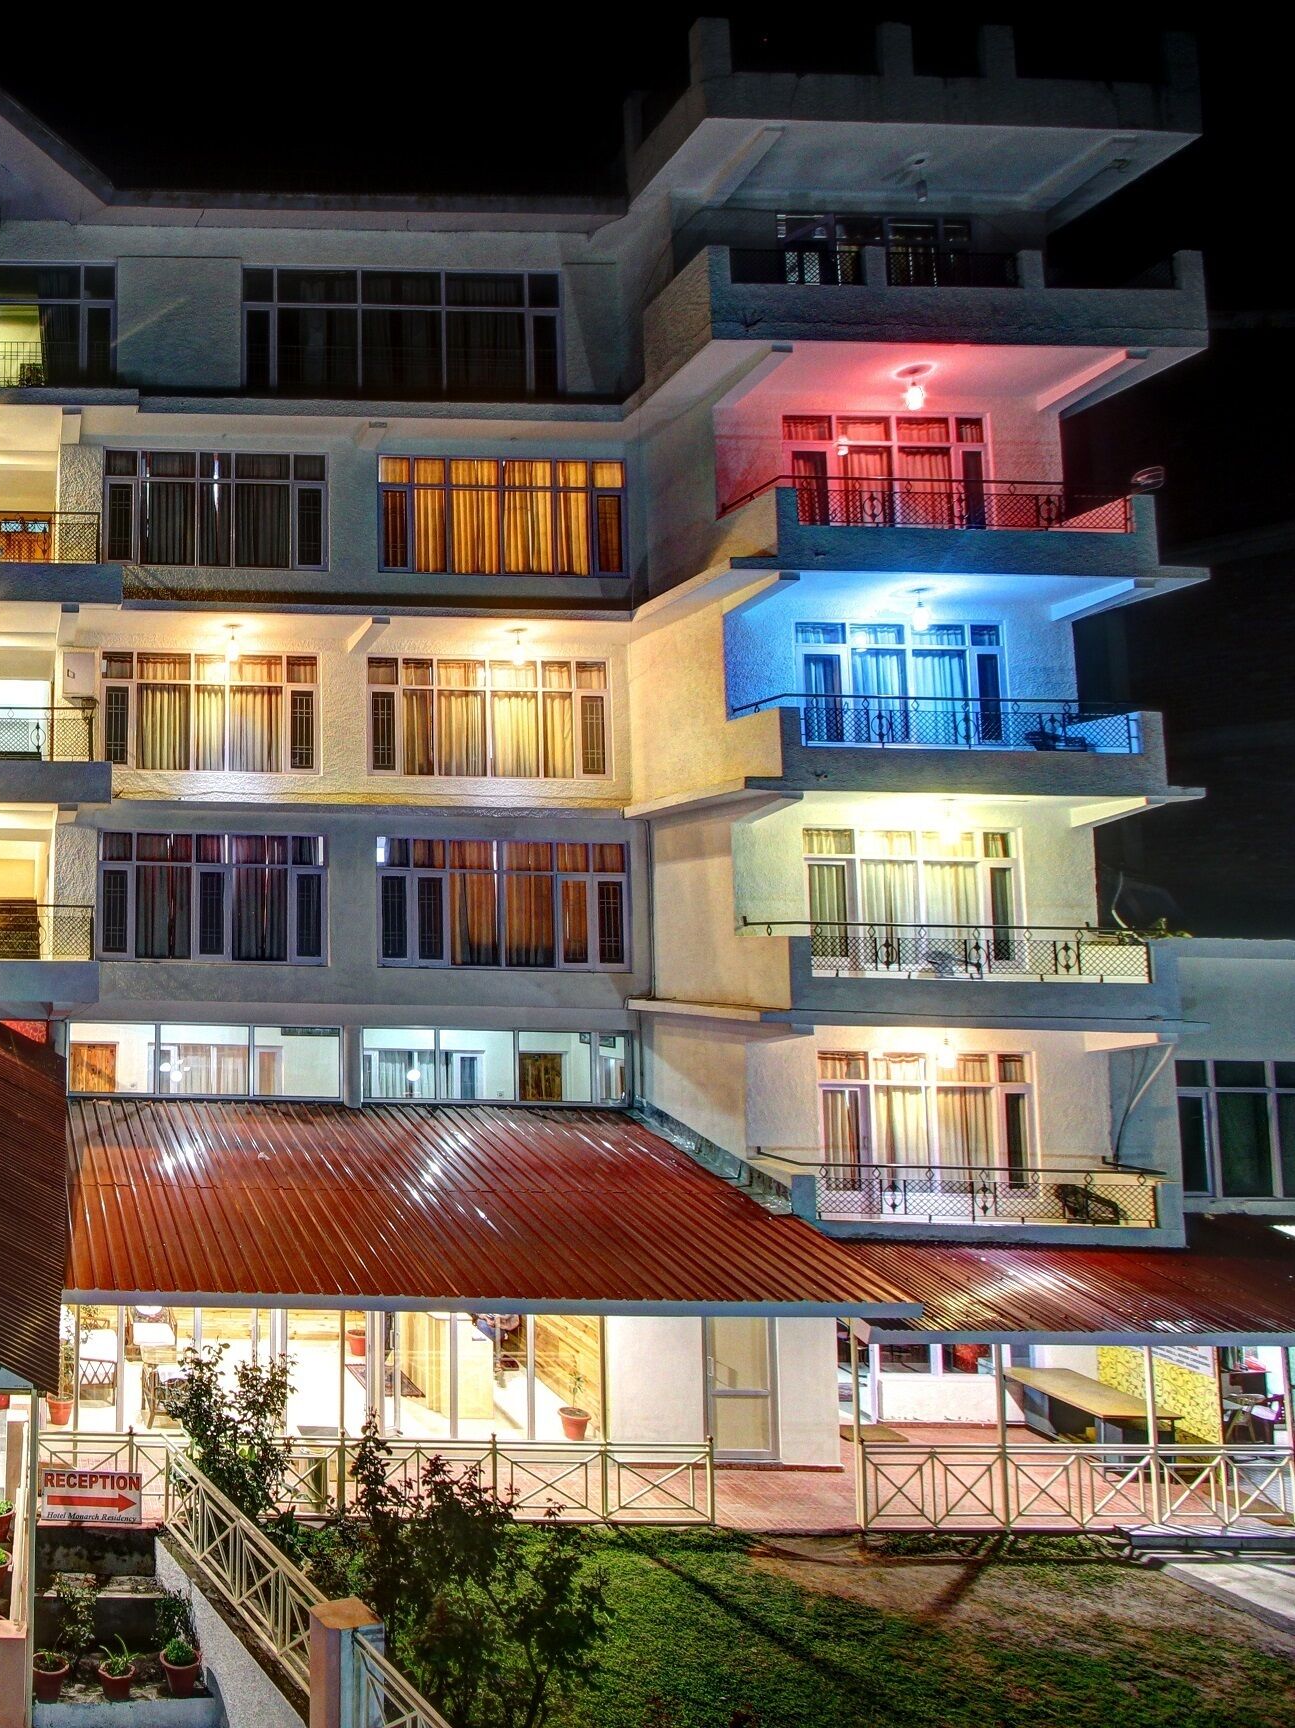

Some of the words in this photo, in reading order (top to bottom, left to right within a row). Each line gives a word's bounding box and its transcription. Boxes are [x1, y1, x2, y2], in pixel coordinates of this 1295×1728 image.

[44, 1472, 140, 1491] RECEPTION
[68, 1512, 99, 1520] Monarch
[101, 1513, 137, 1522] Residency
